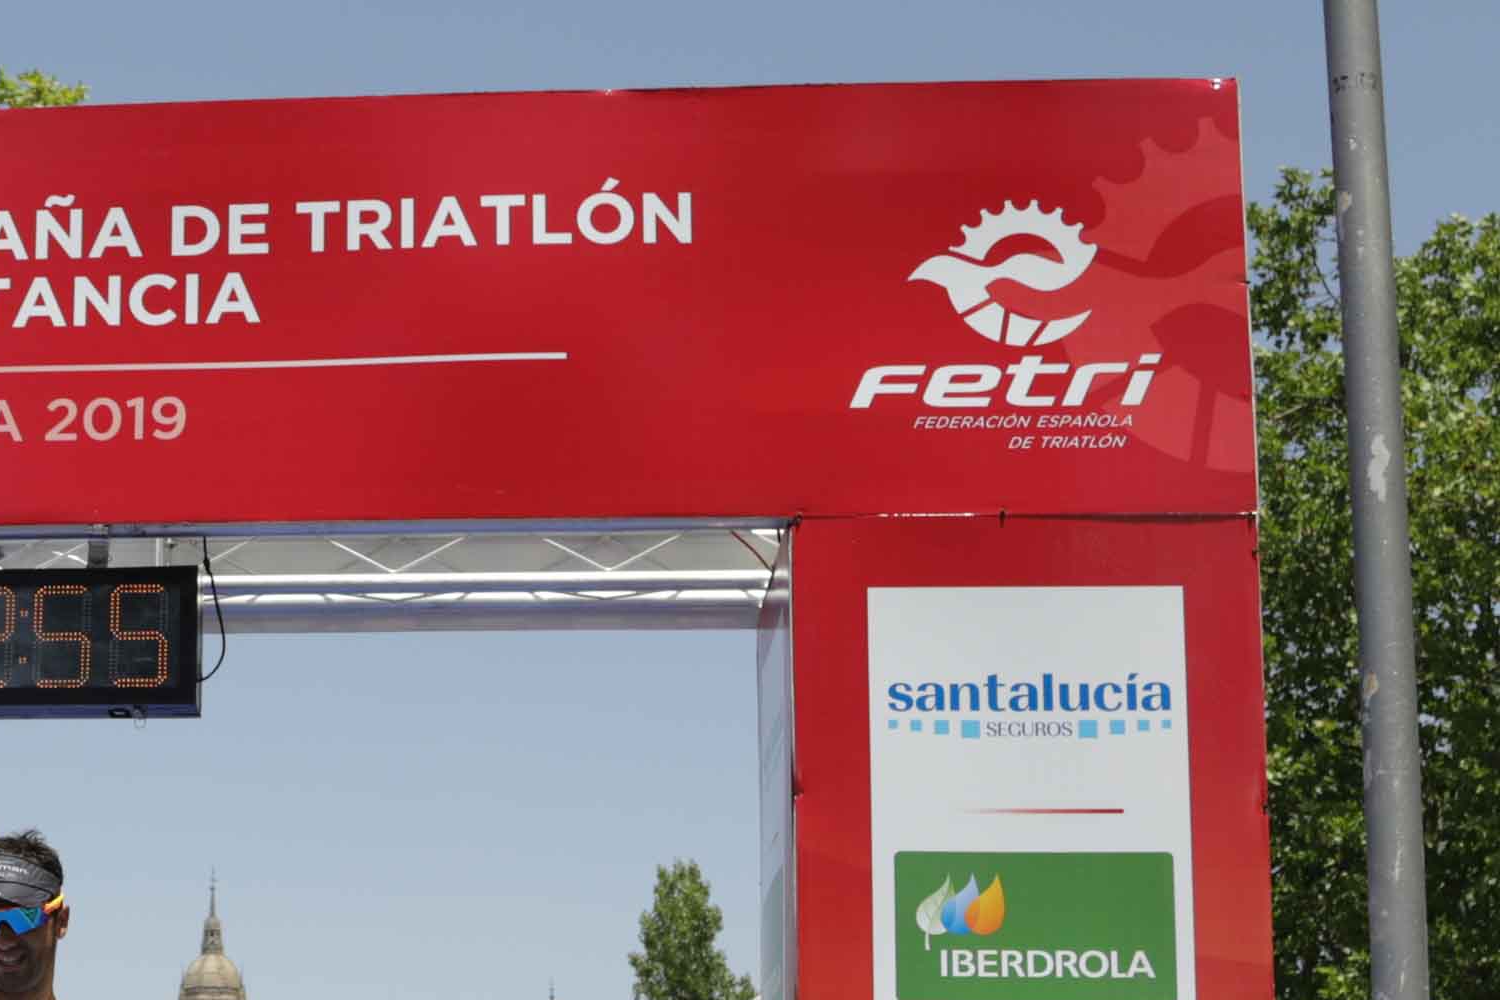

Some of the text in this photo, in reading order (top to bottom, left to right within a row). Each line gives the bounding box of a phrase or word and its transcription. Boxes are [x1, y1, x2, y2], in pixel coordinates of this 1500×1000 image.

[170, 202, 270, 257] DE
[296, 177, 693, 253] TRIATLÓN
[45, 396, 187, 442] 2019
[913, 412, 1134, 430] FEDERACIÓN ESPAÑOLA
[1008, 433, 1127, 450] DE TRIATLÓN
[887, 672, 1172, 713] santalucía
[986, 720, 1073, 738] SEGUROS
[940, 948, 1156, 979] IBERDROLA
